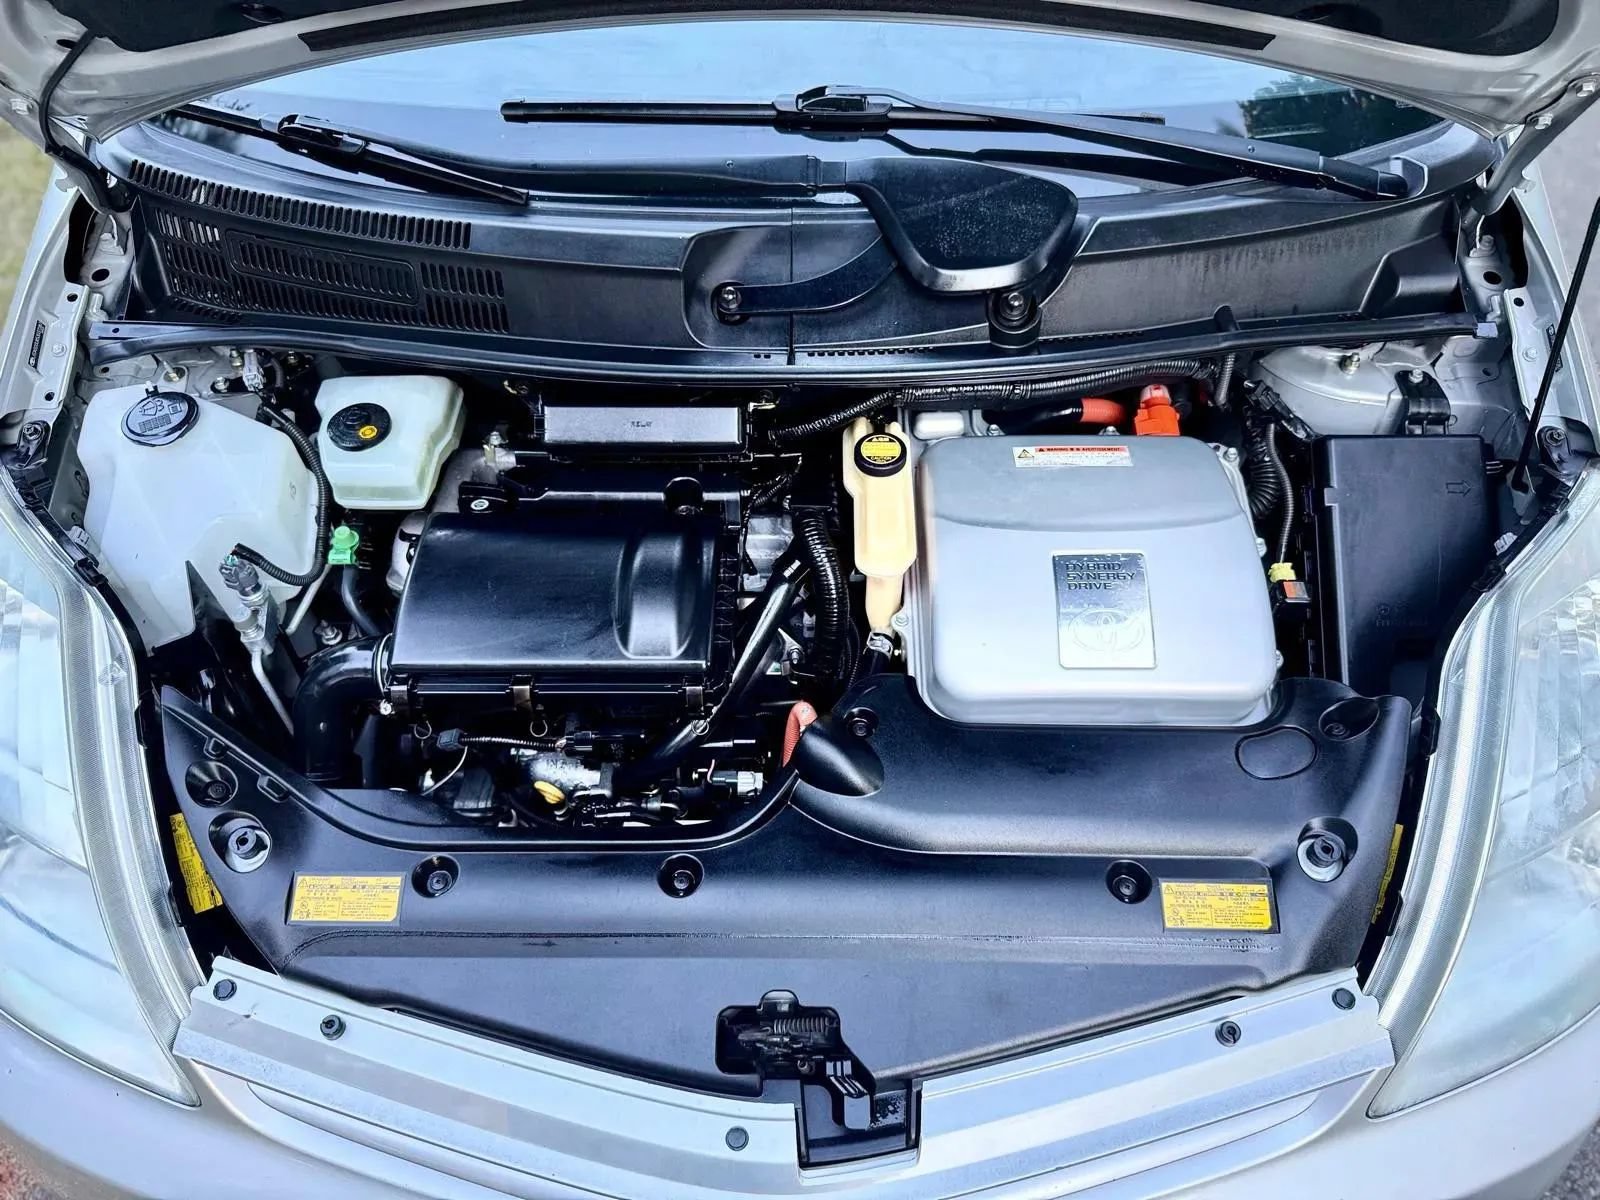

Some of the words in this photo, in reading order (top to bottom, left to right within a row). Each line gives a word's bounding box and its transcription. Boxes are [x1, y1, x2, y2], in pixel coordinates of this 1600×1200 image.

[1065, 562, 1122, 571] HYBRID
[1066, 572, 1135, 580] SYNERGY
[1067, 582, 1113, 590] DRIVE
